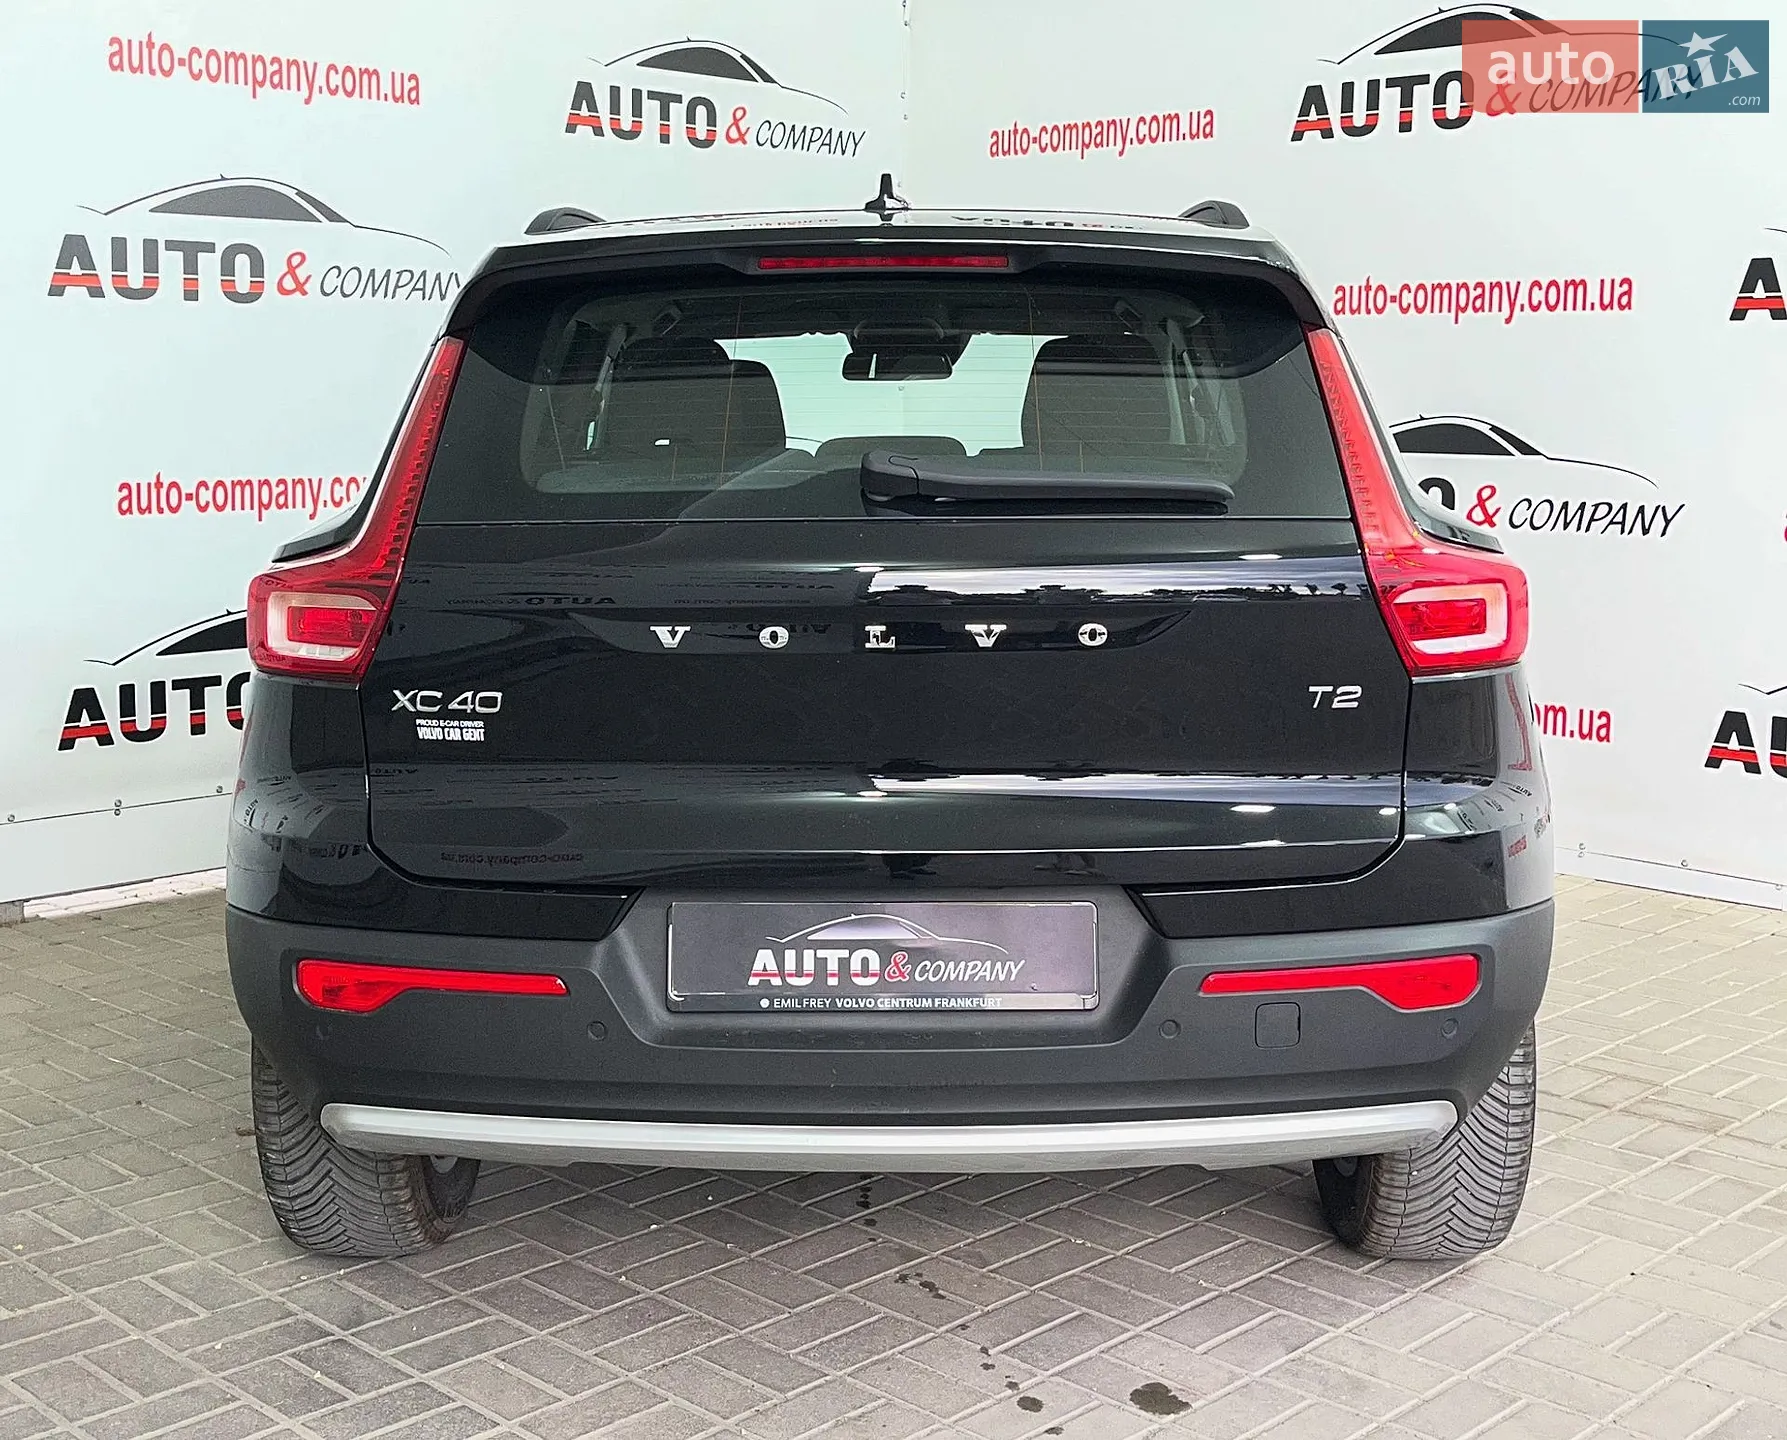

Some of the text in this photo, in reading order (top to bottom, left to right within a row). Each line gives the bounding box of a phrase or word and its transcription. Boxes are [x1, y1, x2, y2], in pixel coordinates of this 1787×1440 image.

[108, 31, 421, 105] auto-company.com.ua
[565, 80, 866, 158] AUTO & COMPANY
[1290, 70, 1475, 142] AUTO
[989, 107, 1214, 160] auto-company.com.ua
[47, 234, 265, 304] AUTO
[276, 251, 312, 297] &
[1333, 275, 1634, 325] auto-company.com.ua
[117, 472, 366, 521] auto-company.co
[1466, 485, 1501, 528] &
[1508, 498, 1685, 537] COMPANY
[650, 623, 1108, 649] VOLVO
[1308, 684, 1363, 709] T2
[416, 727, 485, 741] VOLVO CAR GENT
[748, 949, 1026, 986] AUTO & COMPANY
[774, 998, 1002, 1009] EMIL FREY VOLVO CENTRUM FRANKFURT
